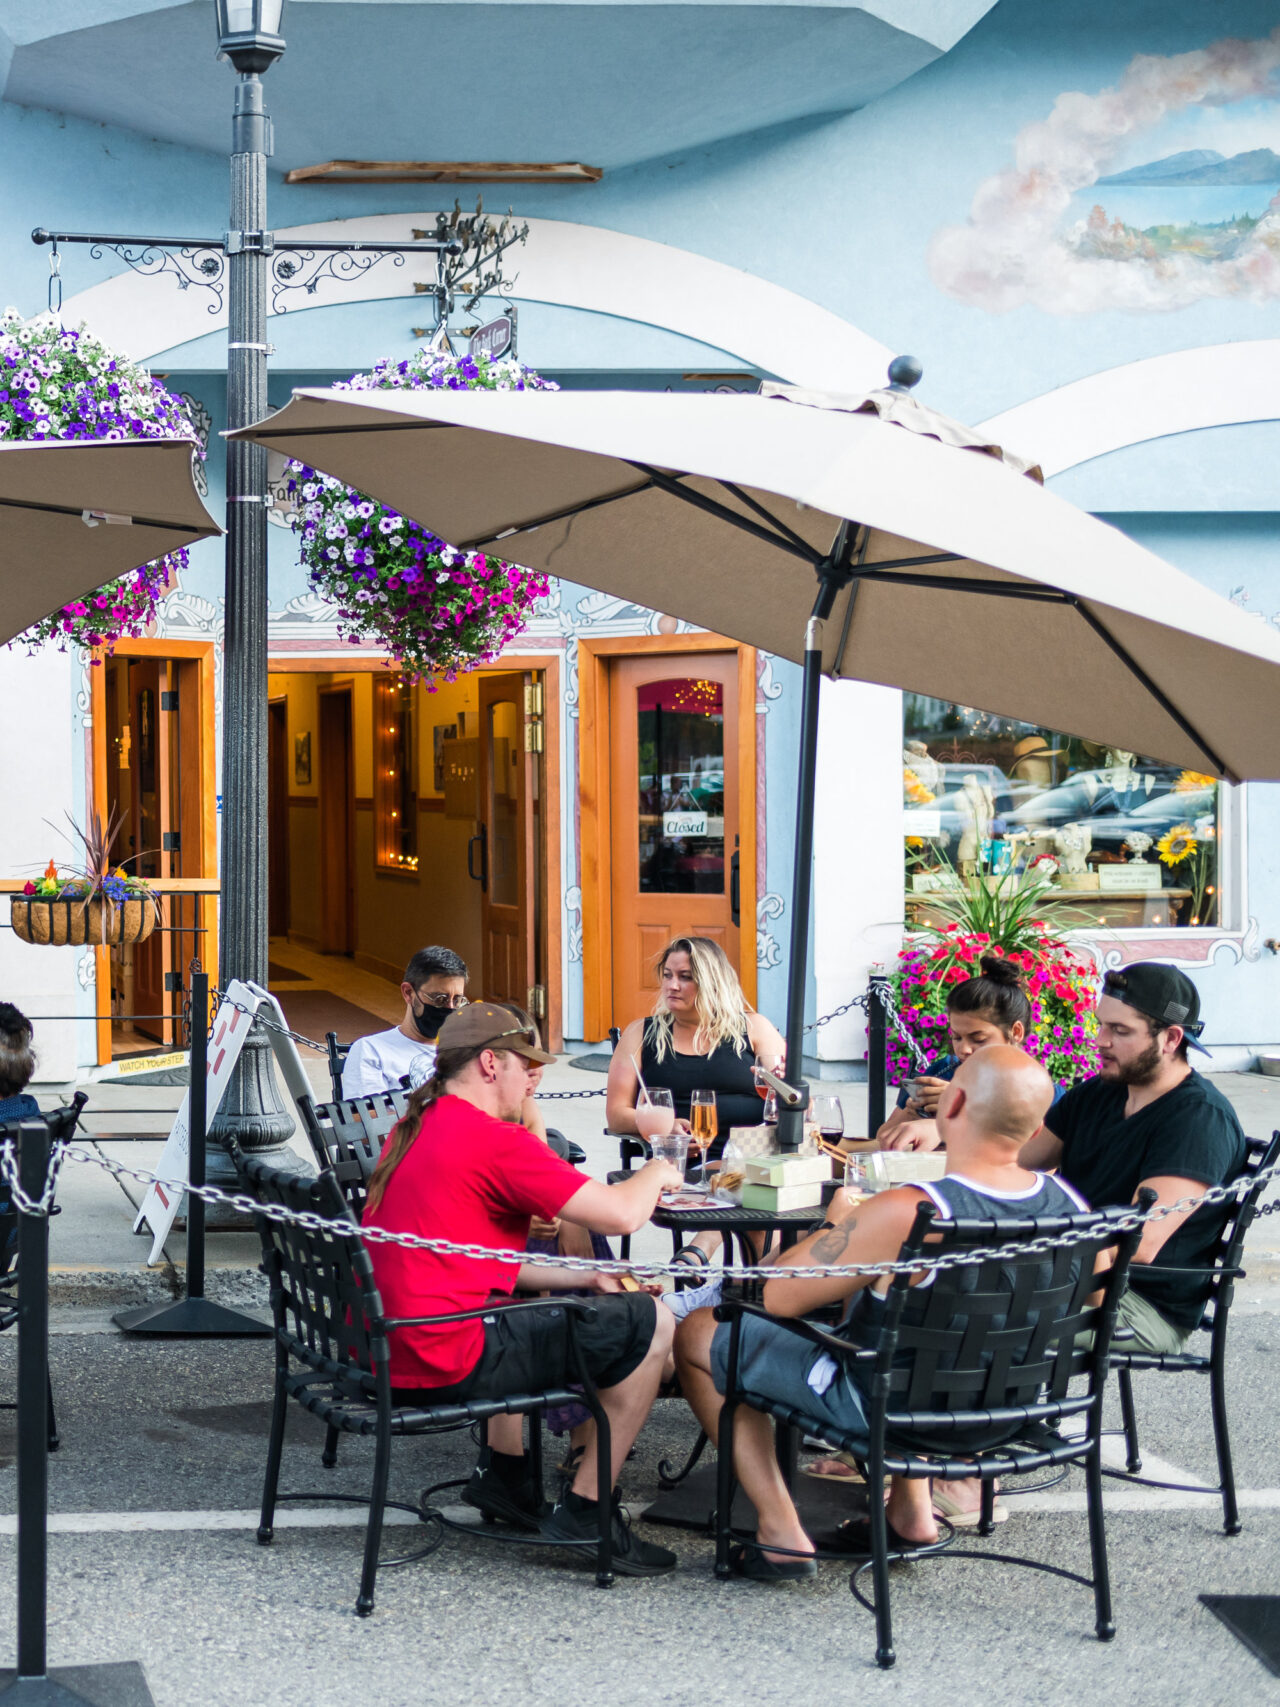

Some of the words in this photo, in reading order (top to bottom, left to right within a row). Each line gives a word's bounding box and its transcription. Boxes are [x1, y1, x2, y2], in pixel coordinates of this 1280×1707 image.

[666, 821, 704, 833] Closed
[119, 1060, 145, 1072] WATCH
[146, 1057, 166, 1068] YOUR
[167, 1054, 184, 1065] STEP
